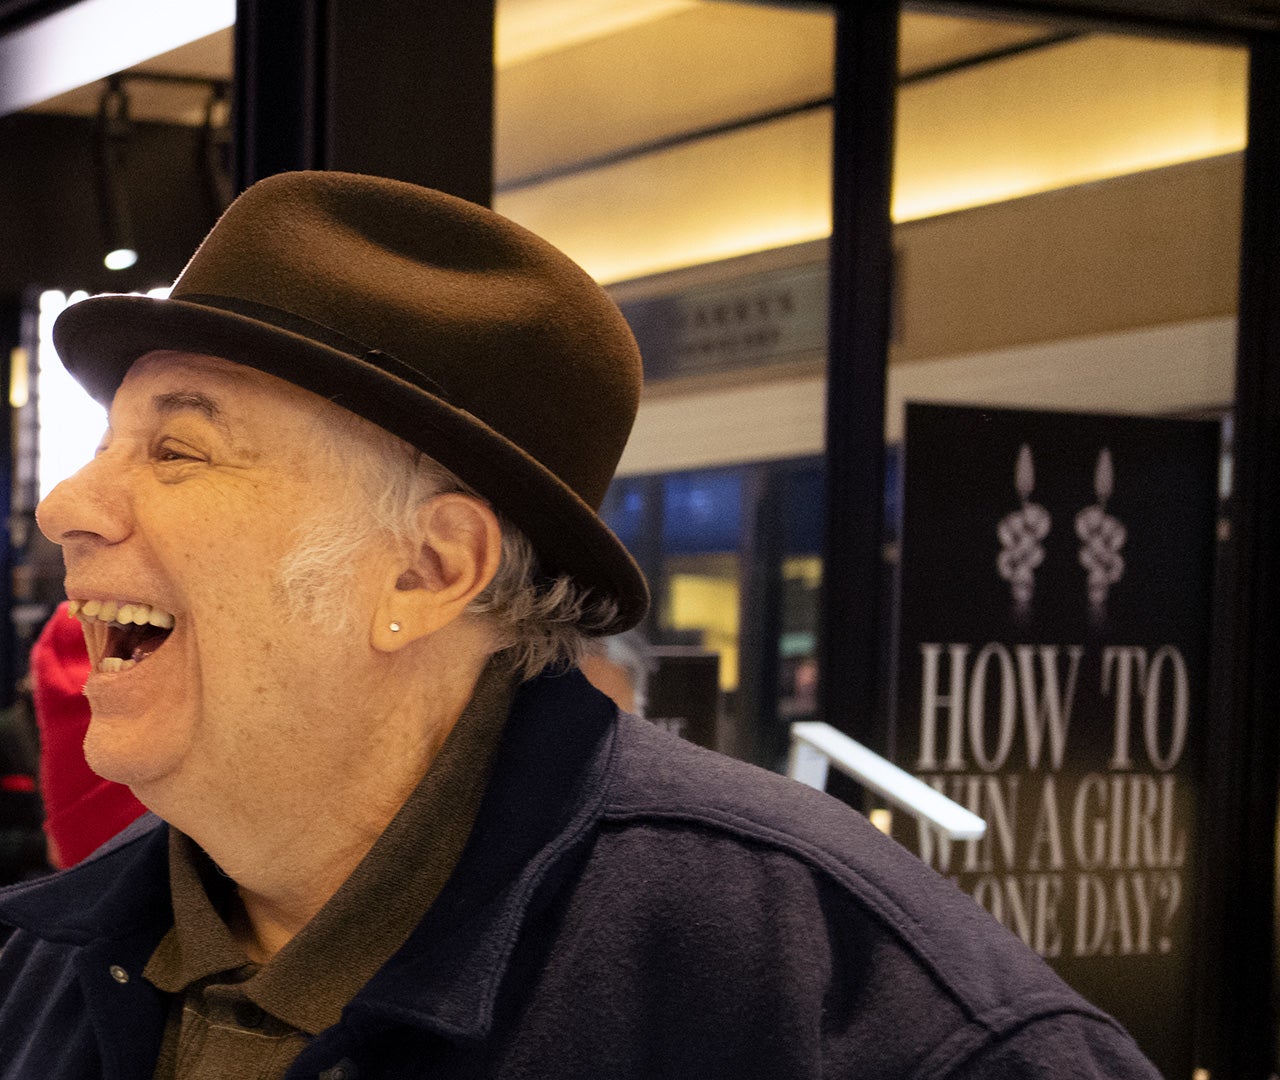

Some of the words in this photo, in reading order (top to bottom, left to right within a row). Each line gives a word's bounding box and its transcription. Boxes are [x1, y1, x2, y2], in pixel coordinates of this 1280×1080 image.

[916, 642, 1083, 772] HOW
[1101, 644, 1189, 772] TO
[1028, 774, 1063, 872] A
[1073, 773, 1187, 872] GIRL
[1075, 874, 1182, 957] DAY?
